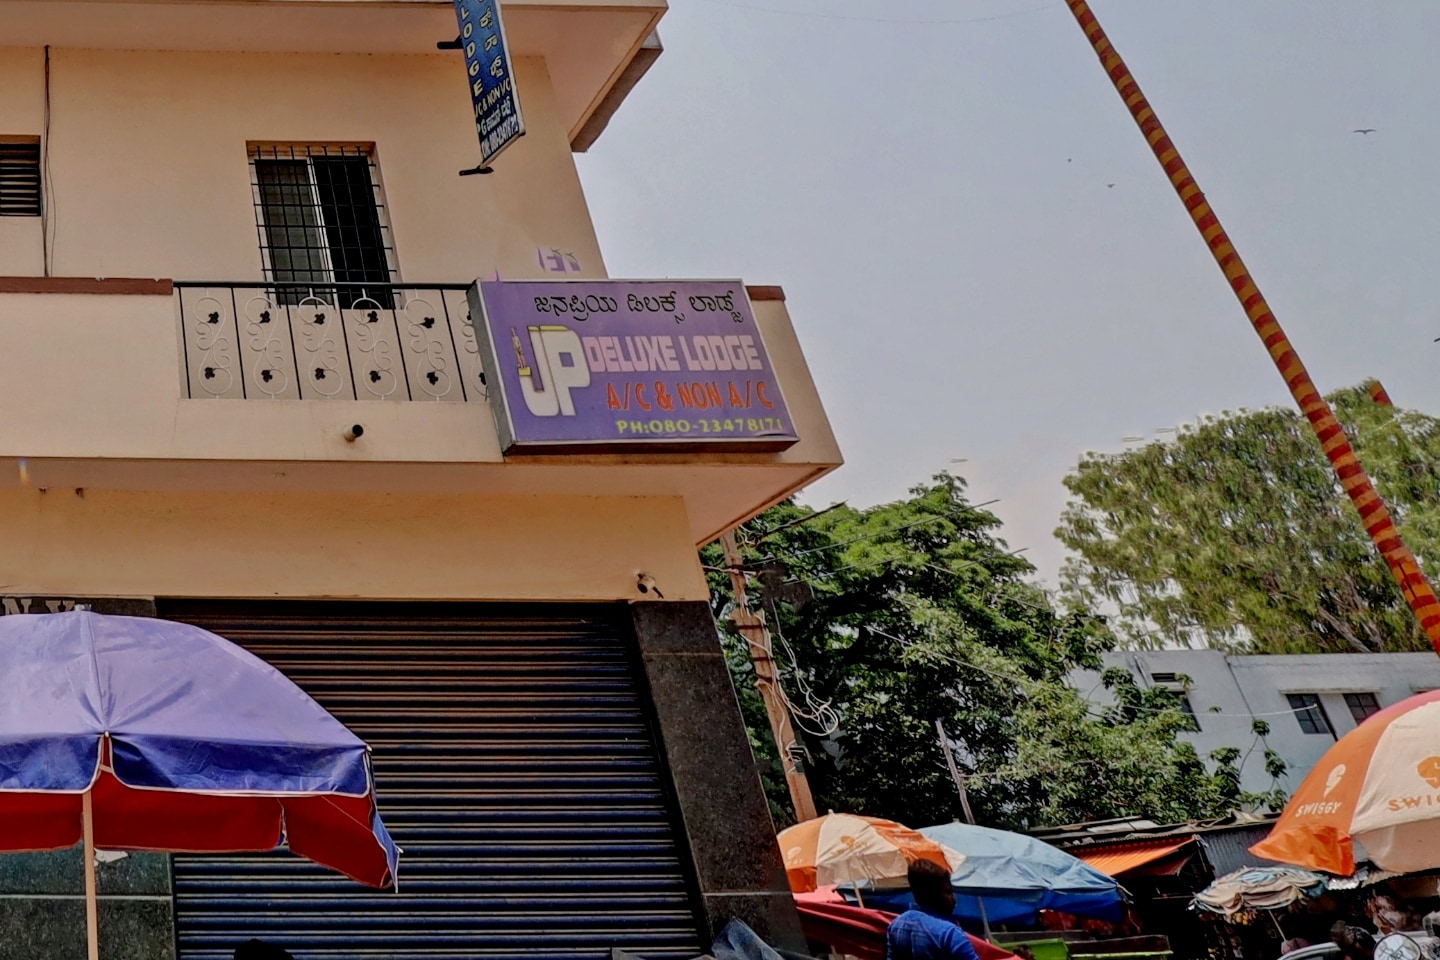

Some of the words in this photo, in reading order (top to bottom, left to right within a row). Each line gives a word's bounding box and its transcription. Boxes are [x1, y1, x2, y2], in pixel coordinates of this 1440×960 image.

[460, 6, 483, 97] LODGE
[518, 324, 591, 417] JP
[584, 335, 680, 372] DELUXE
[683, 334, 763, 371] LODGE
[607, 382, 651, 411] A/C
[656, 382, 675, 411] &
[676, 381, 725, 410] NON
[729, 380, 775, 410] A/C
[1295, 801, 1343, 818] SWIGGY
